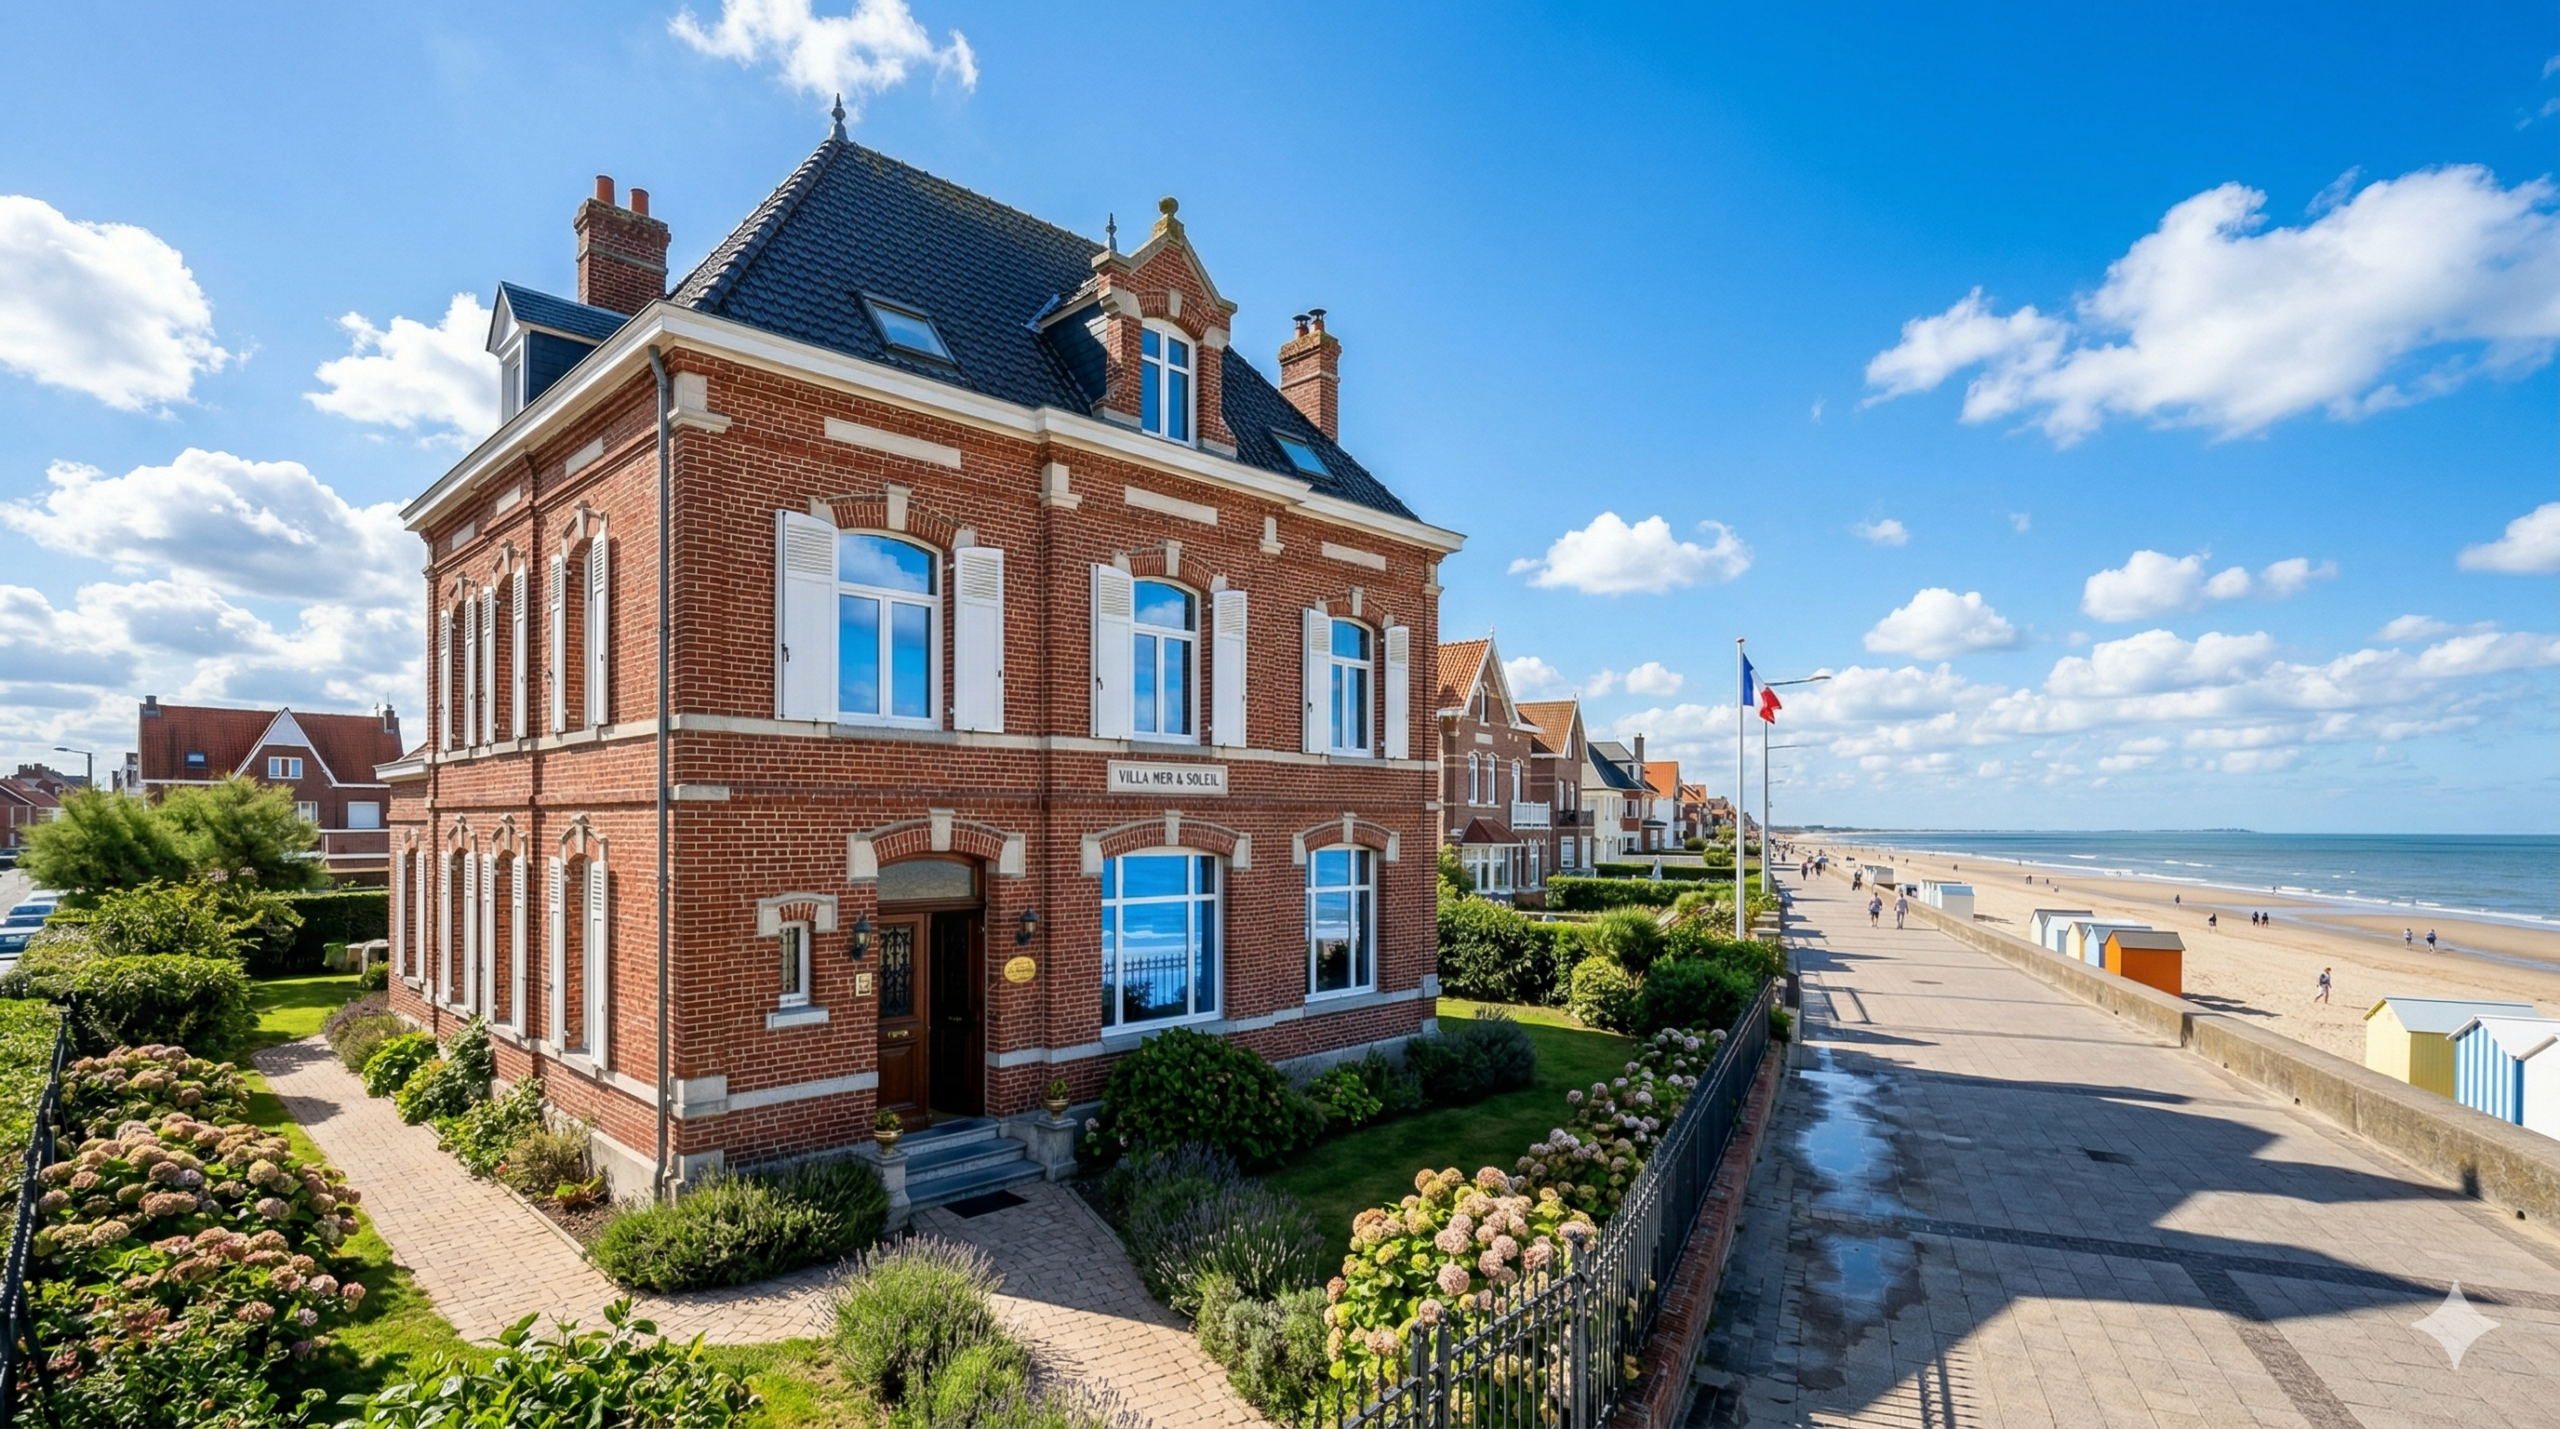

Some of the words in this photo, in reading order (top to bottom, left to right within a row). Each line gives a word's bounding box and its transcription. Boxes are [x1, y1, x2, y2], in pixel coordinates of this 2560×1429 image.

[1119, 769, 1149, 784] VILLA
[1153, 771, 1173, 785] MER
[1176, 773, 1184, 785] &
[1186, 773, 1219, 786] SOLEIL
